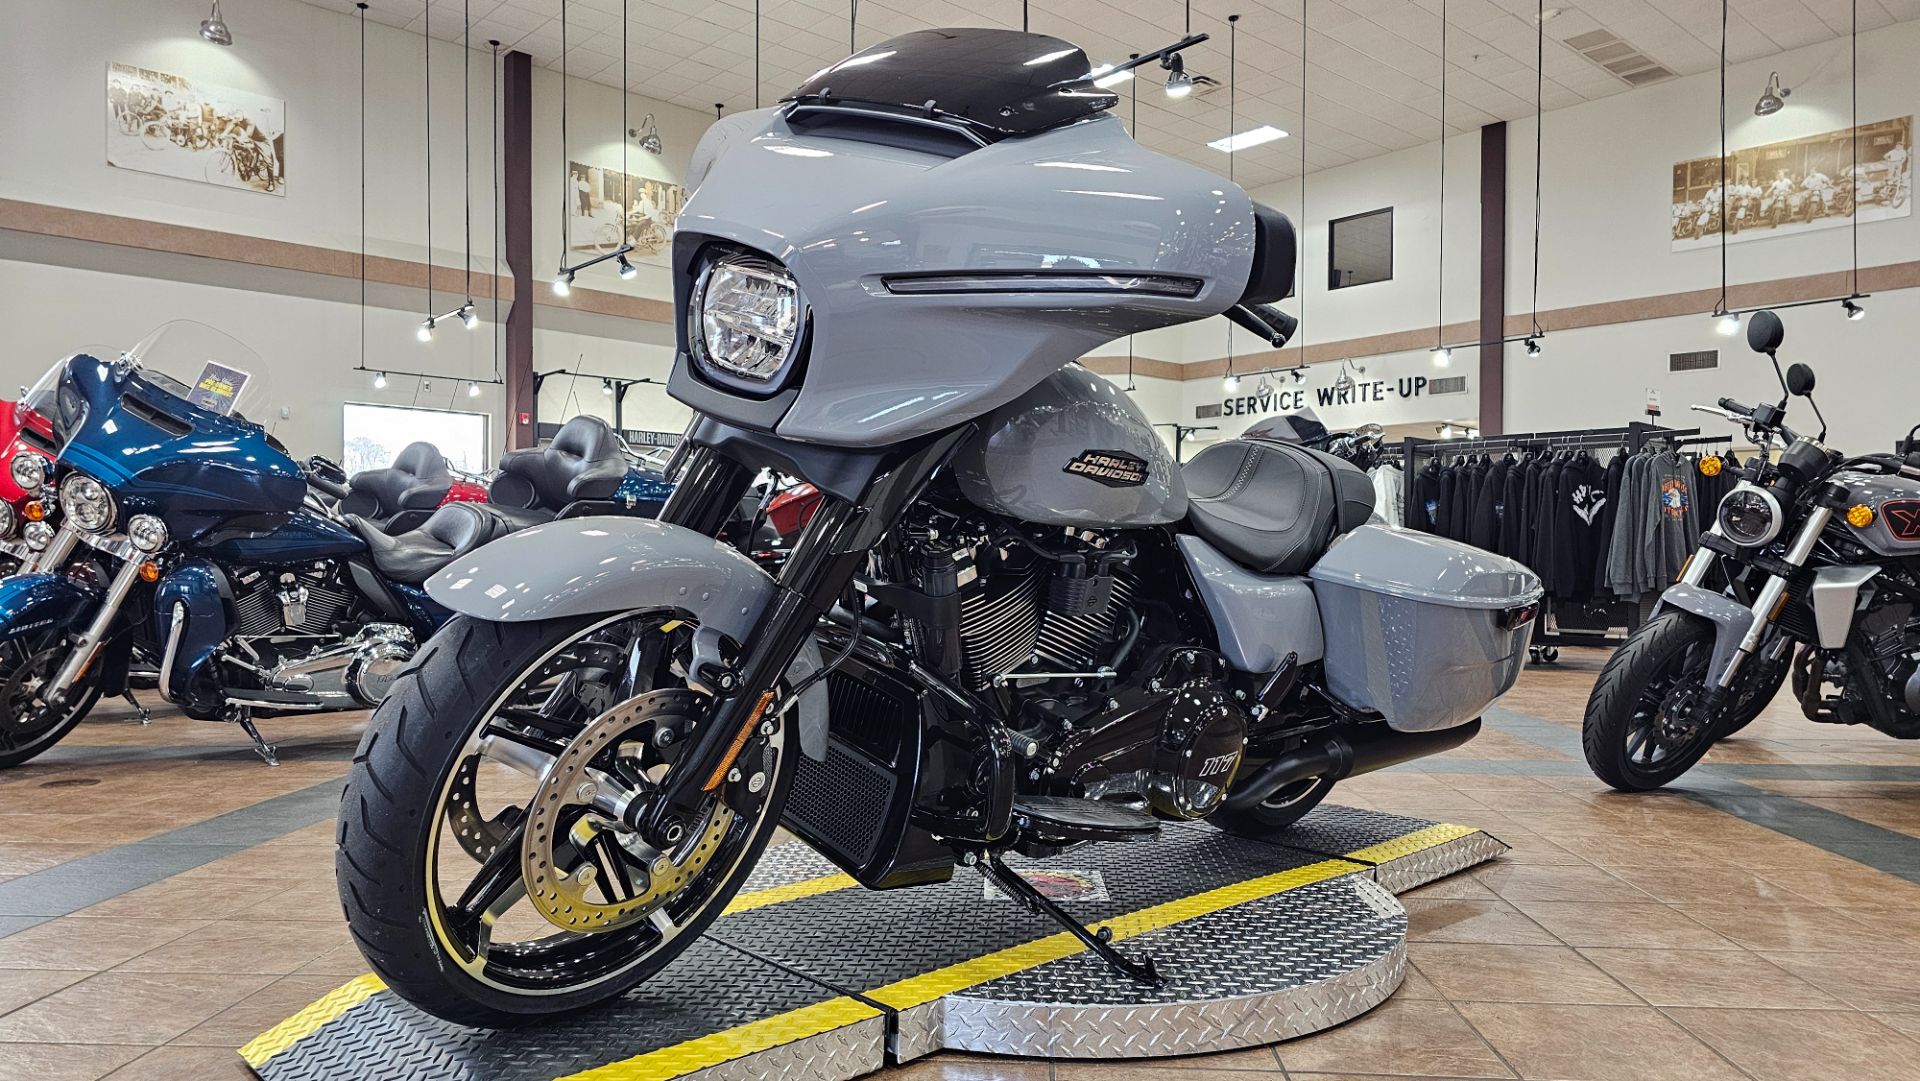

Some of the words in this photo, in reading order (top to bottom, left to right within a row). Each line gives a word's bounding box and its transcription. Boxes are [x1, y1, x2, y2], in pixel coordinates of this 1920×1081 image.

[1224, 390, 1305, 416] SERVICE
[1316, 376, 1427, 407] WRITE-UP
[629, 431, 683, 446] HARLEY-DAVIDS
[1083, 454, 1143, 472] HARLEY
[1199, 751, 1239, 777] 117
